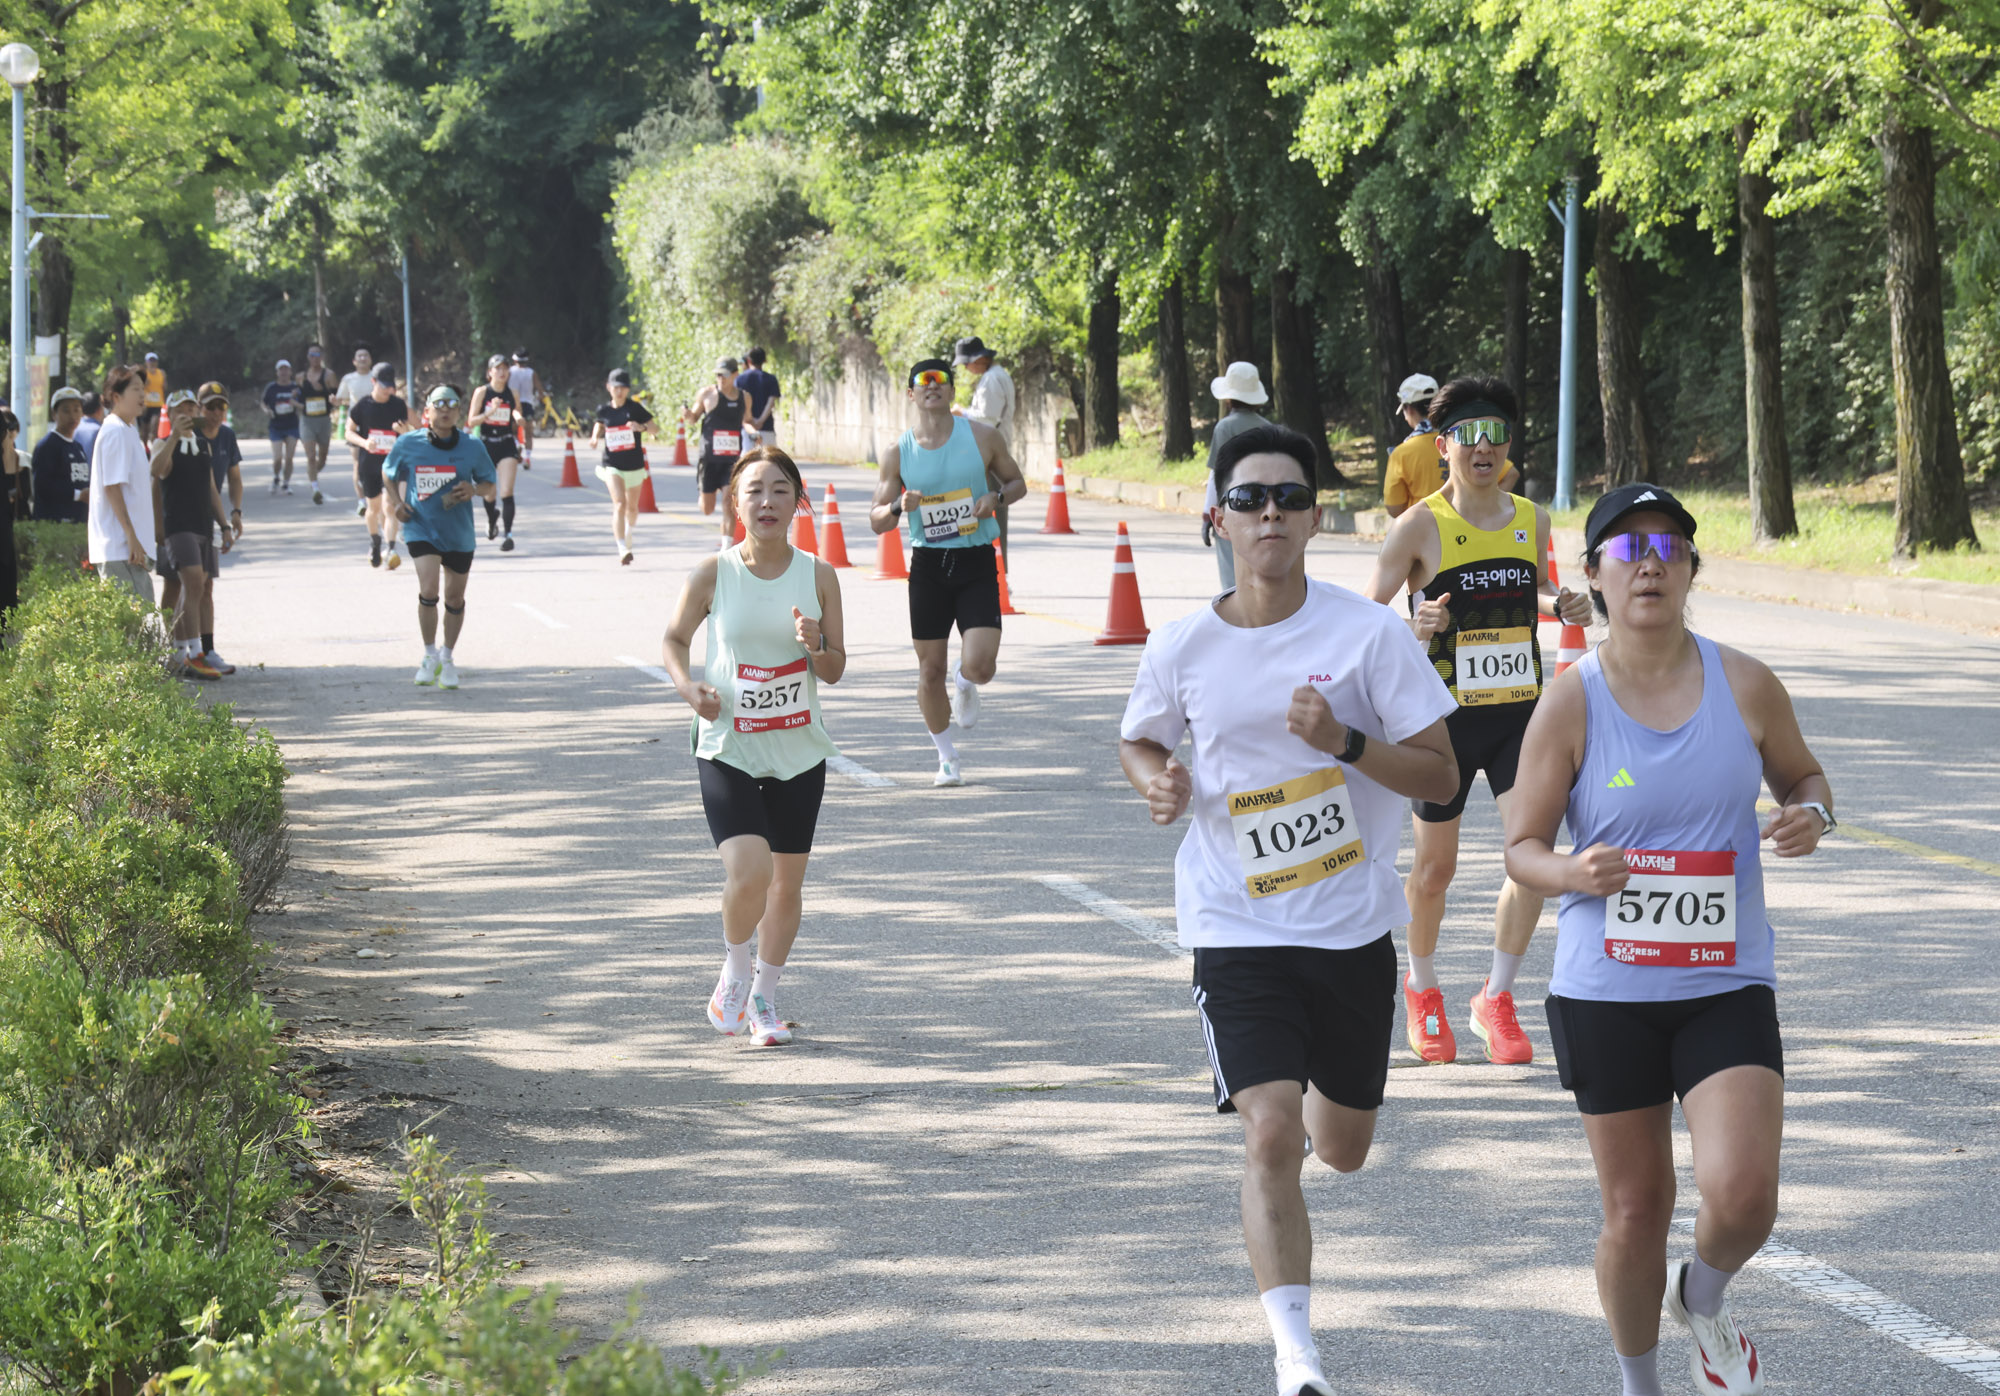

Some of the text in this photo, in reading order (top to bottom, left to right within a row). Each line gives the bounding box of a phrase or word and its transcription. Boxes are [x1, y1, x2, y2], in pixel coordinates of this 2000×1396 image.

[928, 504, 972, 525] 1292
[1459, 568, 1531, 590] 건국에이스
[1461, 632, 1500, 642] 시사저널
[1465, 652, 1528, 679] 1050
[1308, 674, 1332, 683] FILA
[740, 681, 802, 710] 5257
[1510, 689, 1535, 699] 10 km
[785, 716, 806, 727] 5 km
[1235, 788, 1286, 809] 시사저널
[1246, 803, 1346, 860] 1023
[1321, 848, 1358, 873] 10 km
[1617, 889, 1726, 926] 5705
[1690, 948, 1725, 961] 5 km
